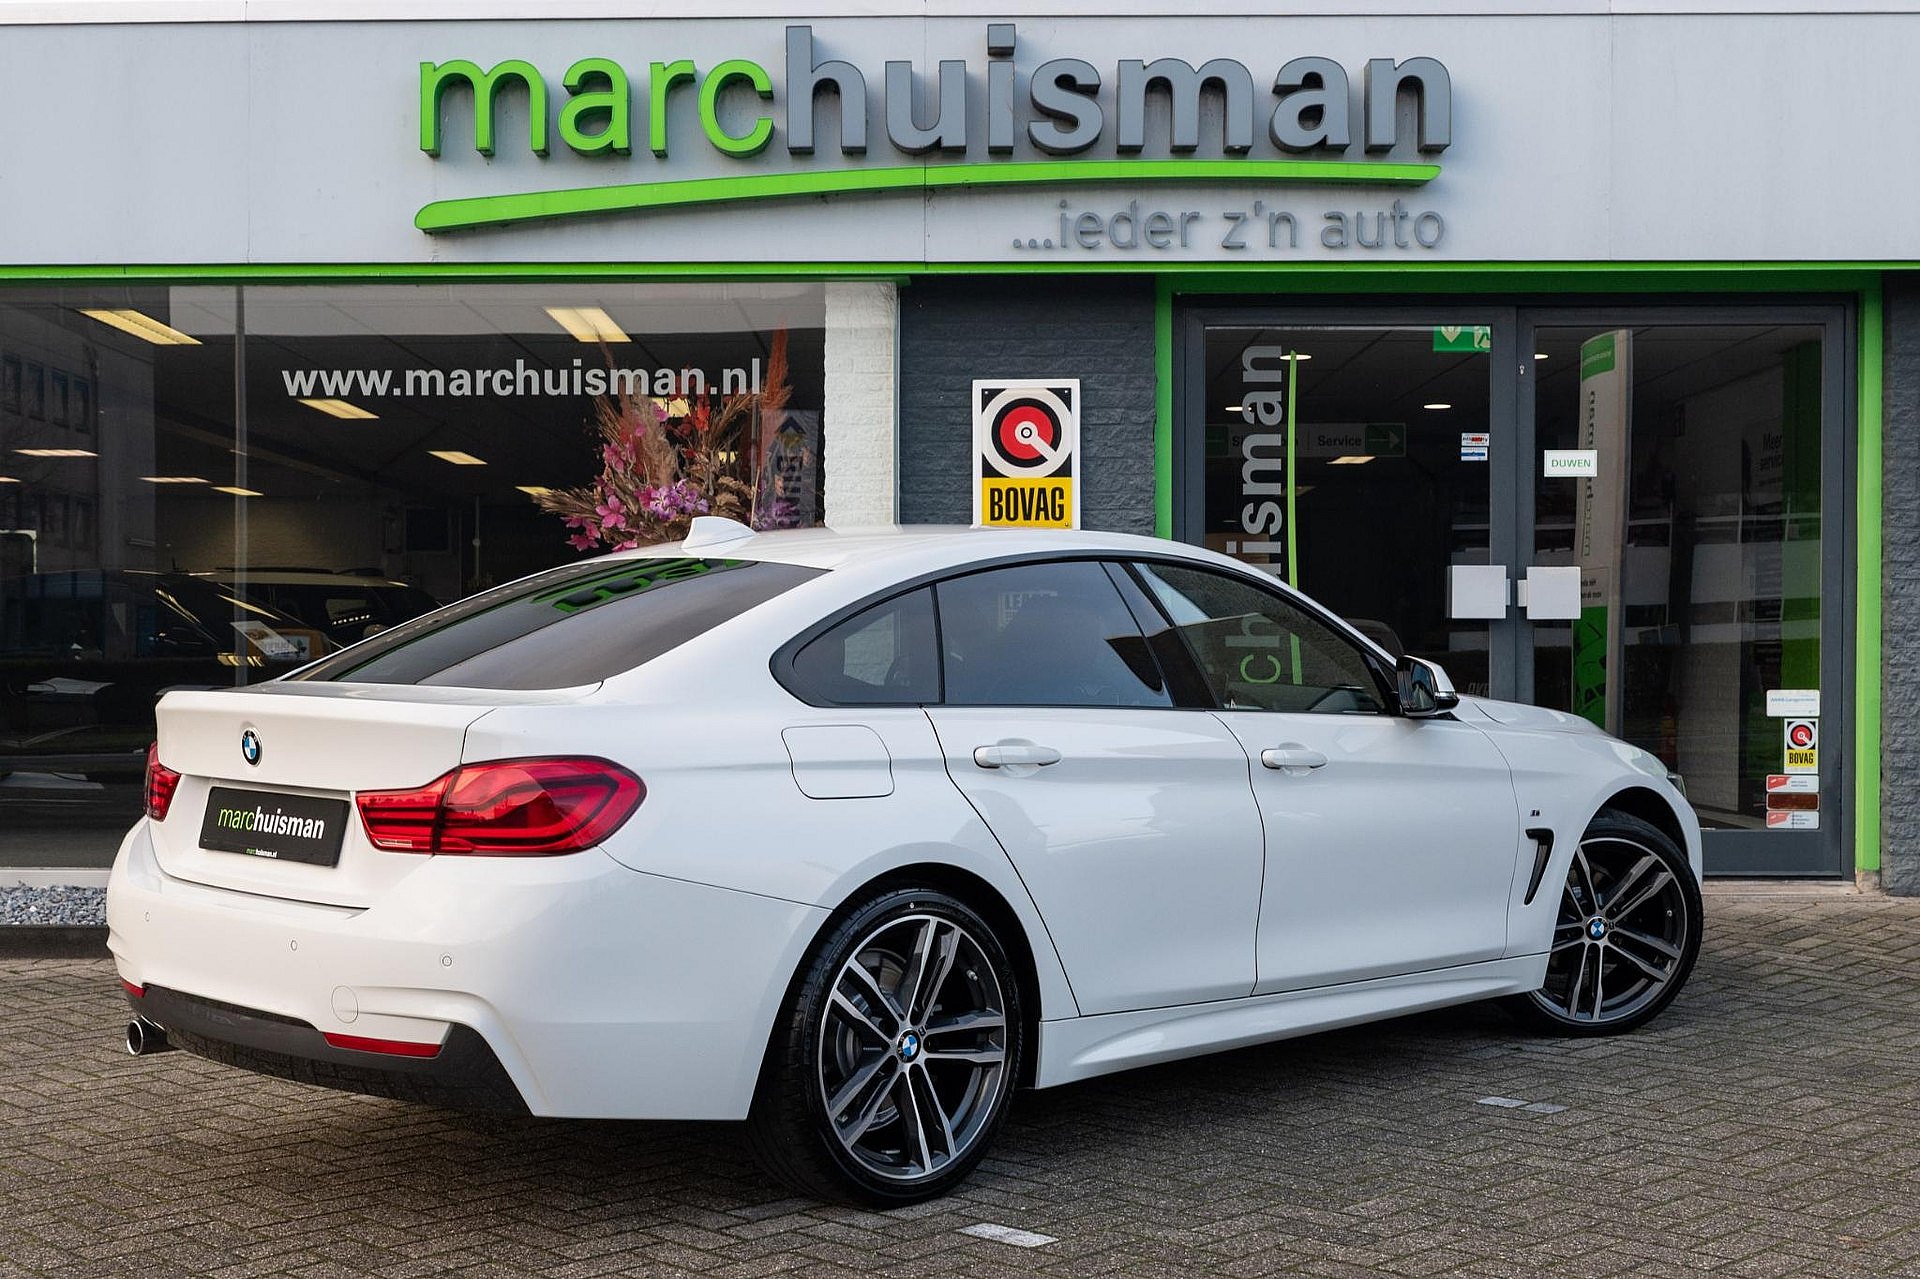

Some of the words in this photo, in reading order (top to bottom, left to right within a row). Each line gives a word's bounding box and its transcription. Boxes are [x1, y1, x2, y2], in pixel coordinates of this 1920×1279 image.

[419, 23, 1452, 158] marchuisman
[1220, 200, 1298, 249] z'n
[1320, 200, 1447, 250] auto
[281, 357, 761, 397] www.marchuisman.nl
[1551, 458, 1592, 468] DUWEN
[989, 486, 1065, 522] BOVAG
[1788, 752, 1814, 764] BOVAG
[217, 805, 326, 840] marchuisman
